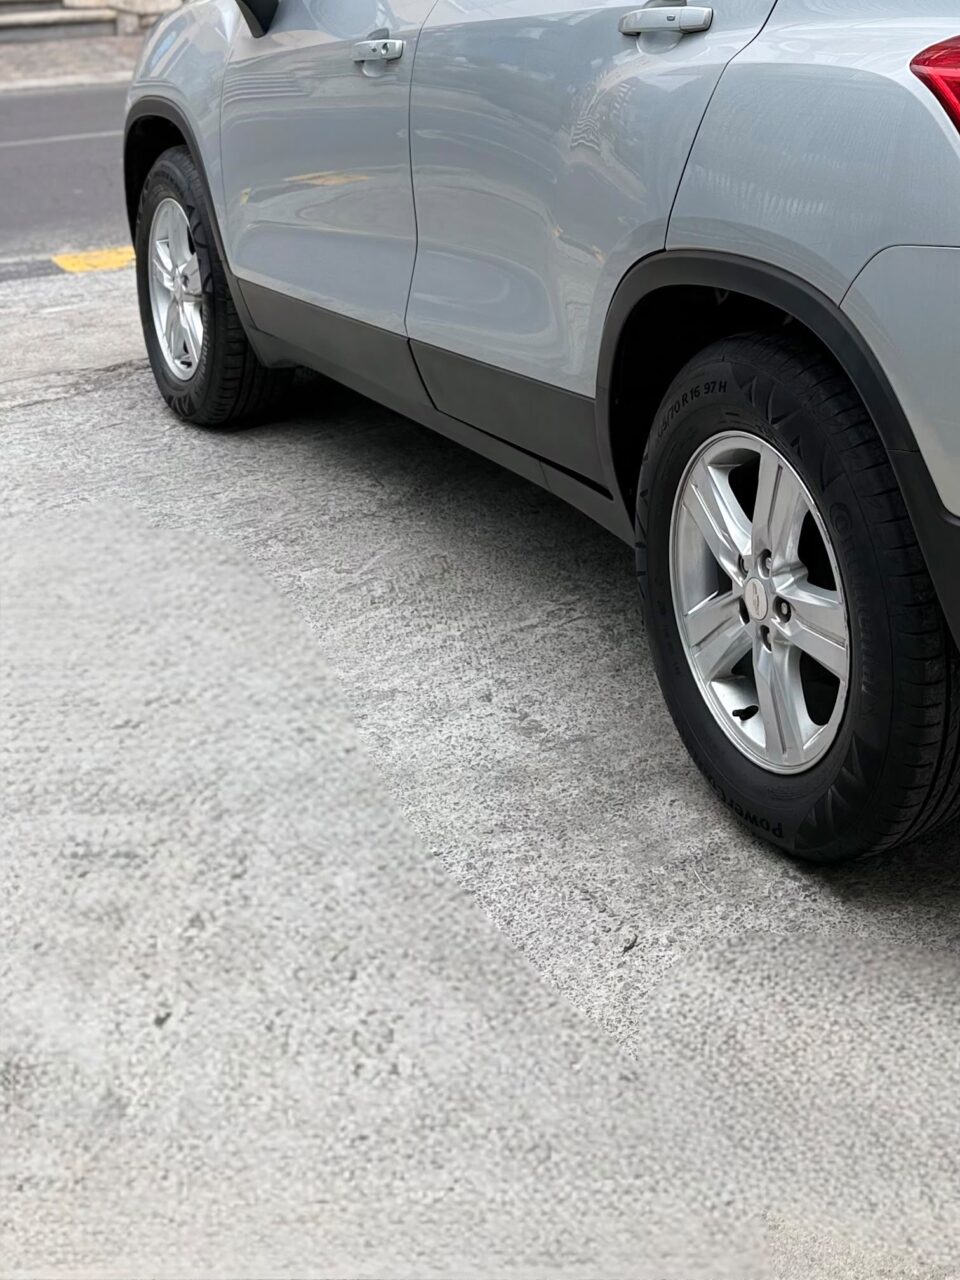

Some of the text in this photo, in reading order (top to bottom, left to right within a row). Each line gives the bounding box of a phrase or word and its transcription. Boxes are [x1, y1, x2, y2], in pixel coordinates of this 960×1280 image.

[681, 392, 689, 407] R
[689, 384, 701, 400] 16
[703, 380, 717, 395] 97
[719, 380, 727, 393] H
